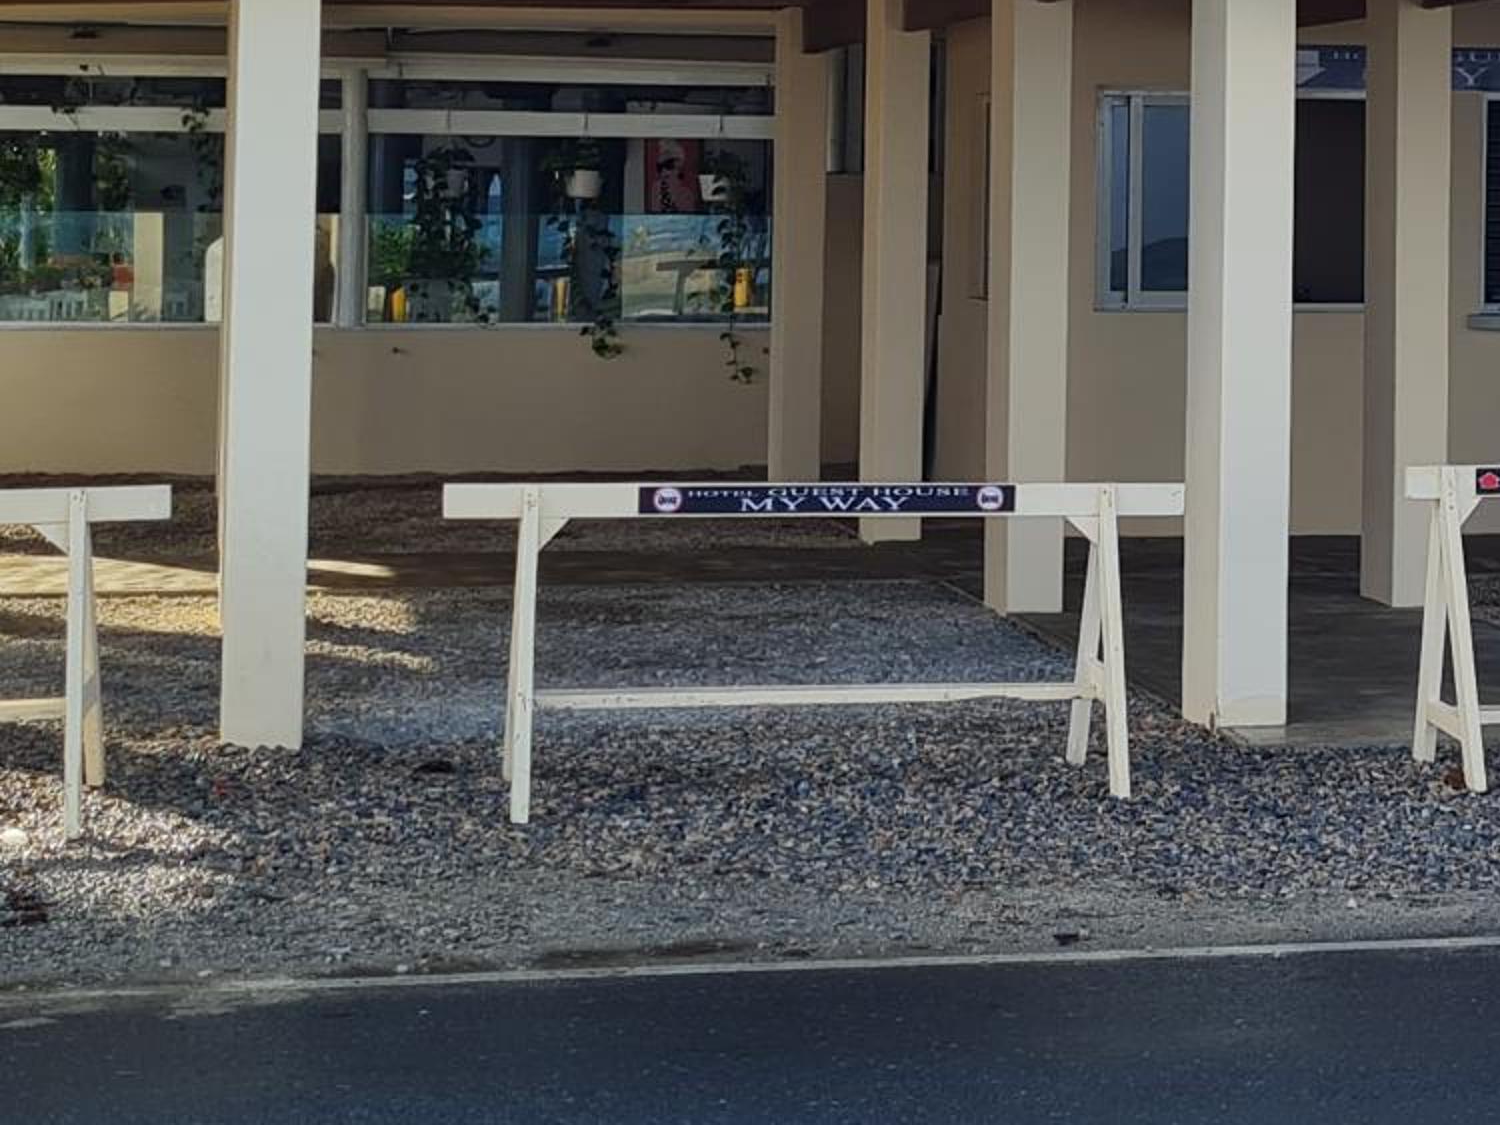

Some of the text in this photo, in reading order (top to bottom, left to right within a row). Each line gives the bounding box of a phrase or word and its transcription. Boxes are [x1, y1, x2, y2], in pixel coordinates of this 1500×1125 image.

[768, 487, 863, 496] GUEST
[873, 487, 969, 496] HOUSE
[740, 496, 909, 512] MY WAY
